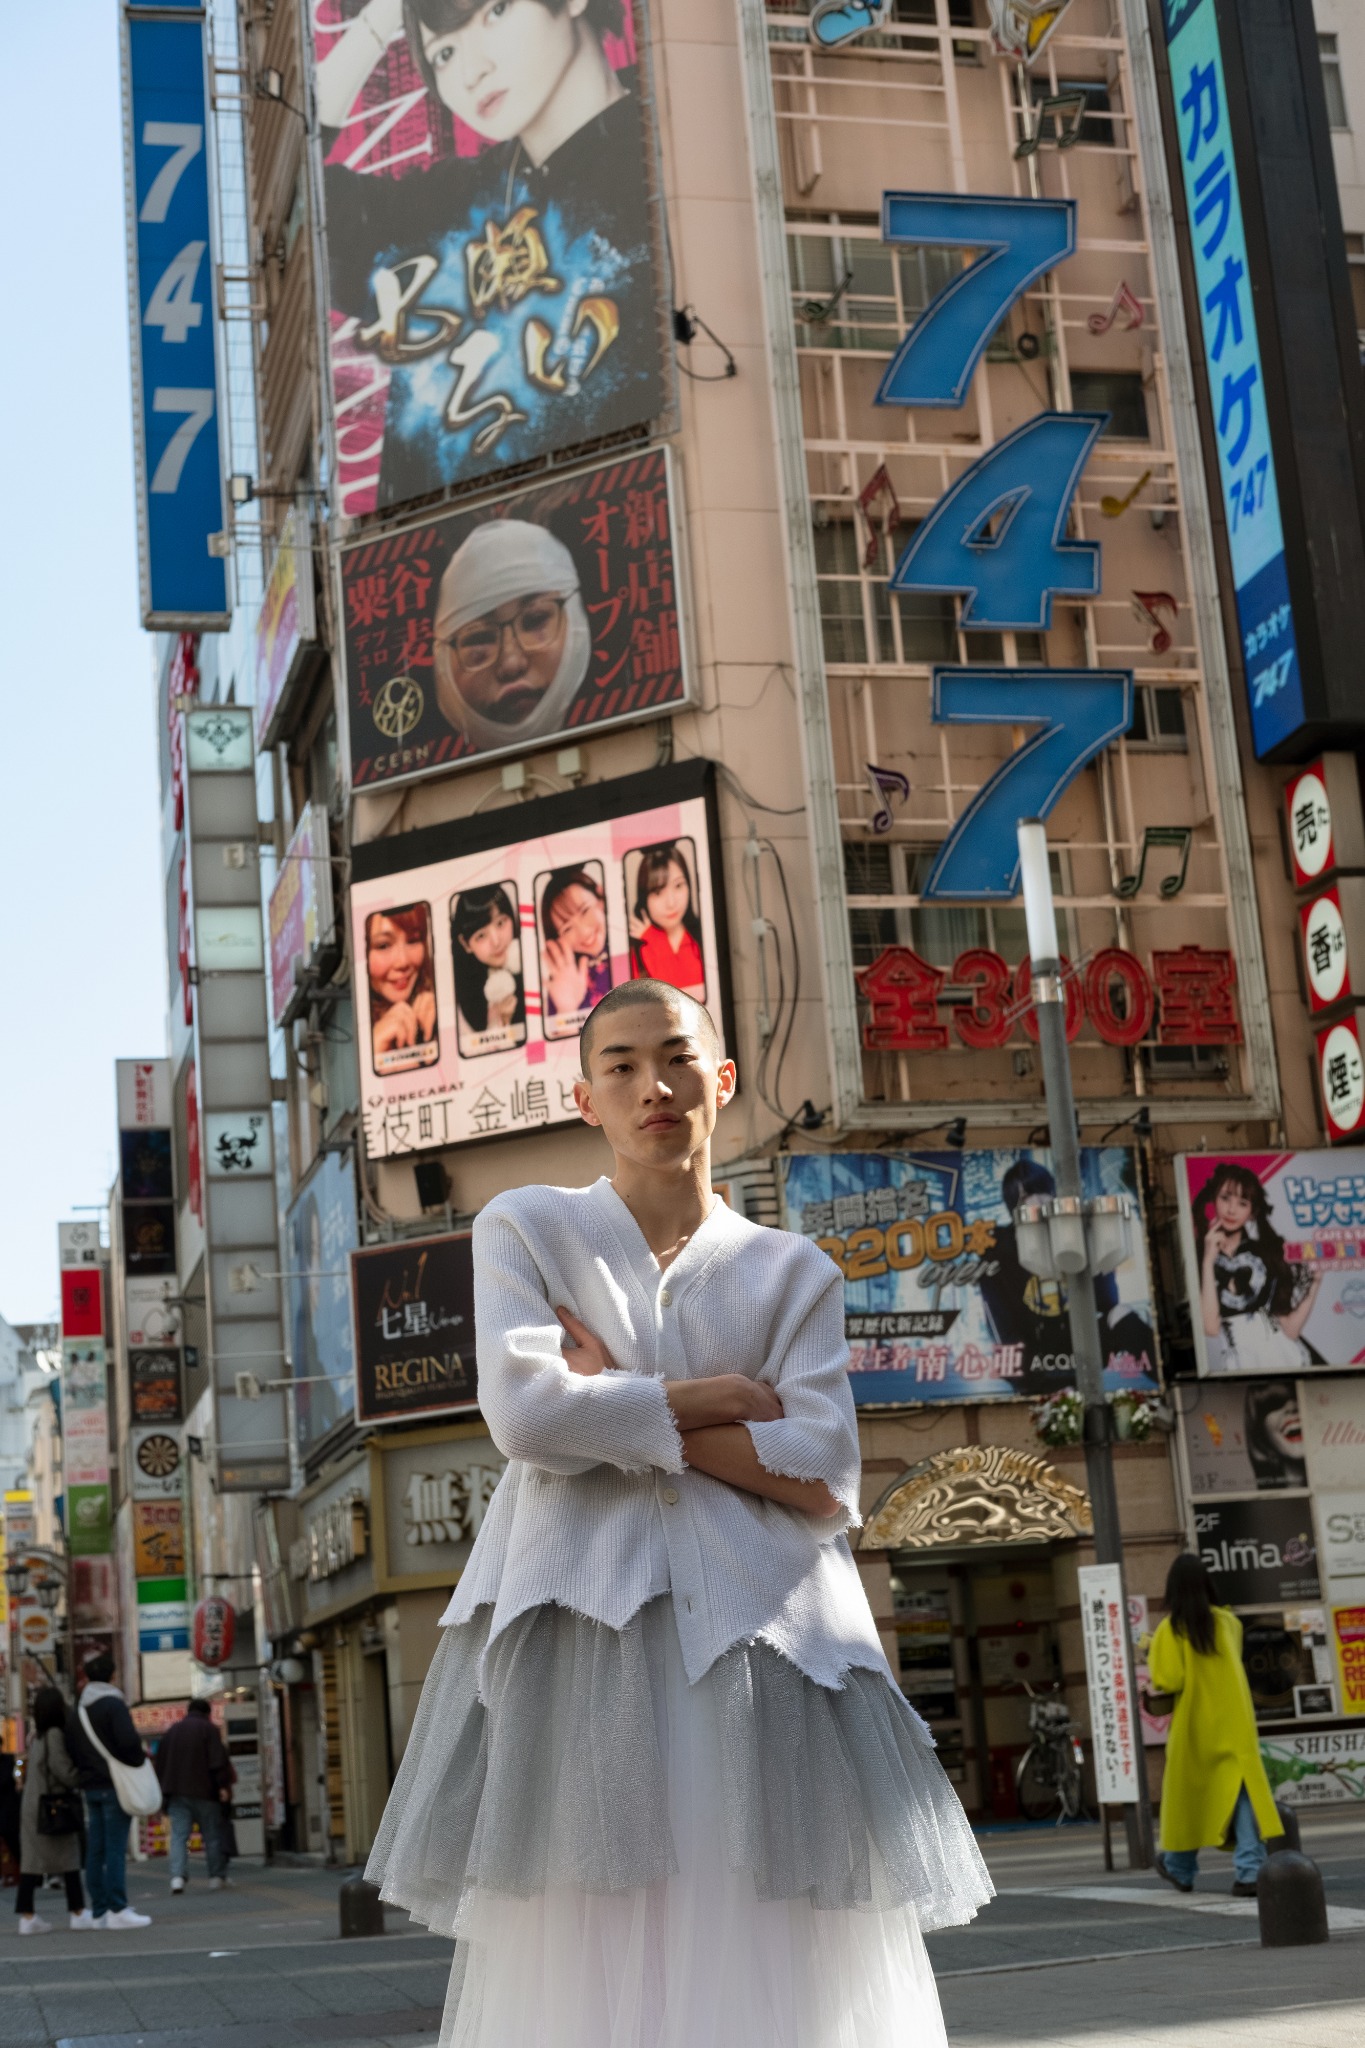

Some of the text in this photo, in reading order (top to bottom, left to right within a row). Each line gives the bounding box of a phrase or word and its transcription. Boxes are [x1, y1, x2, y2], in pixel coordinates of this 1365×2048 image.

[1181, 60, 1258, 467] カラオケ
[139, 121, 215, 494] 747
[1229, 453, 1269, 535] 747
[873, 190, 1133, 901] 747
[580, 500, 630, 688] オープン
[624, 480, 680, 682] 新店舗
[1244, 602, 1292, 660] カラオケ
[1252, 648, 1295, 709] 747
[387, 1081, 465, 1105] ONECARAT
[374, 1300, 432, 1341] 七星
[843, 1314, 945, 1336] 界歴代新記録
[374, 1351, 467, 1392] REGINA
[1195, 1512, 1221, 1533] 2F
[1201, 1539, 1284, 1573] alma
